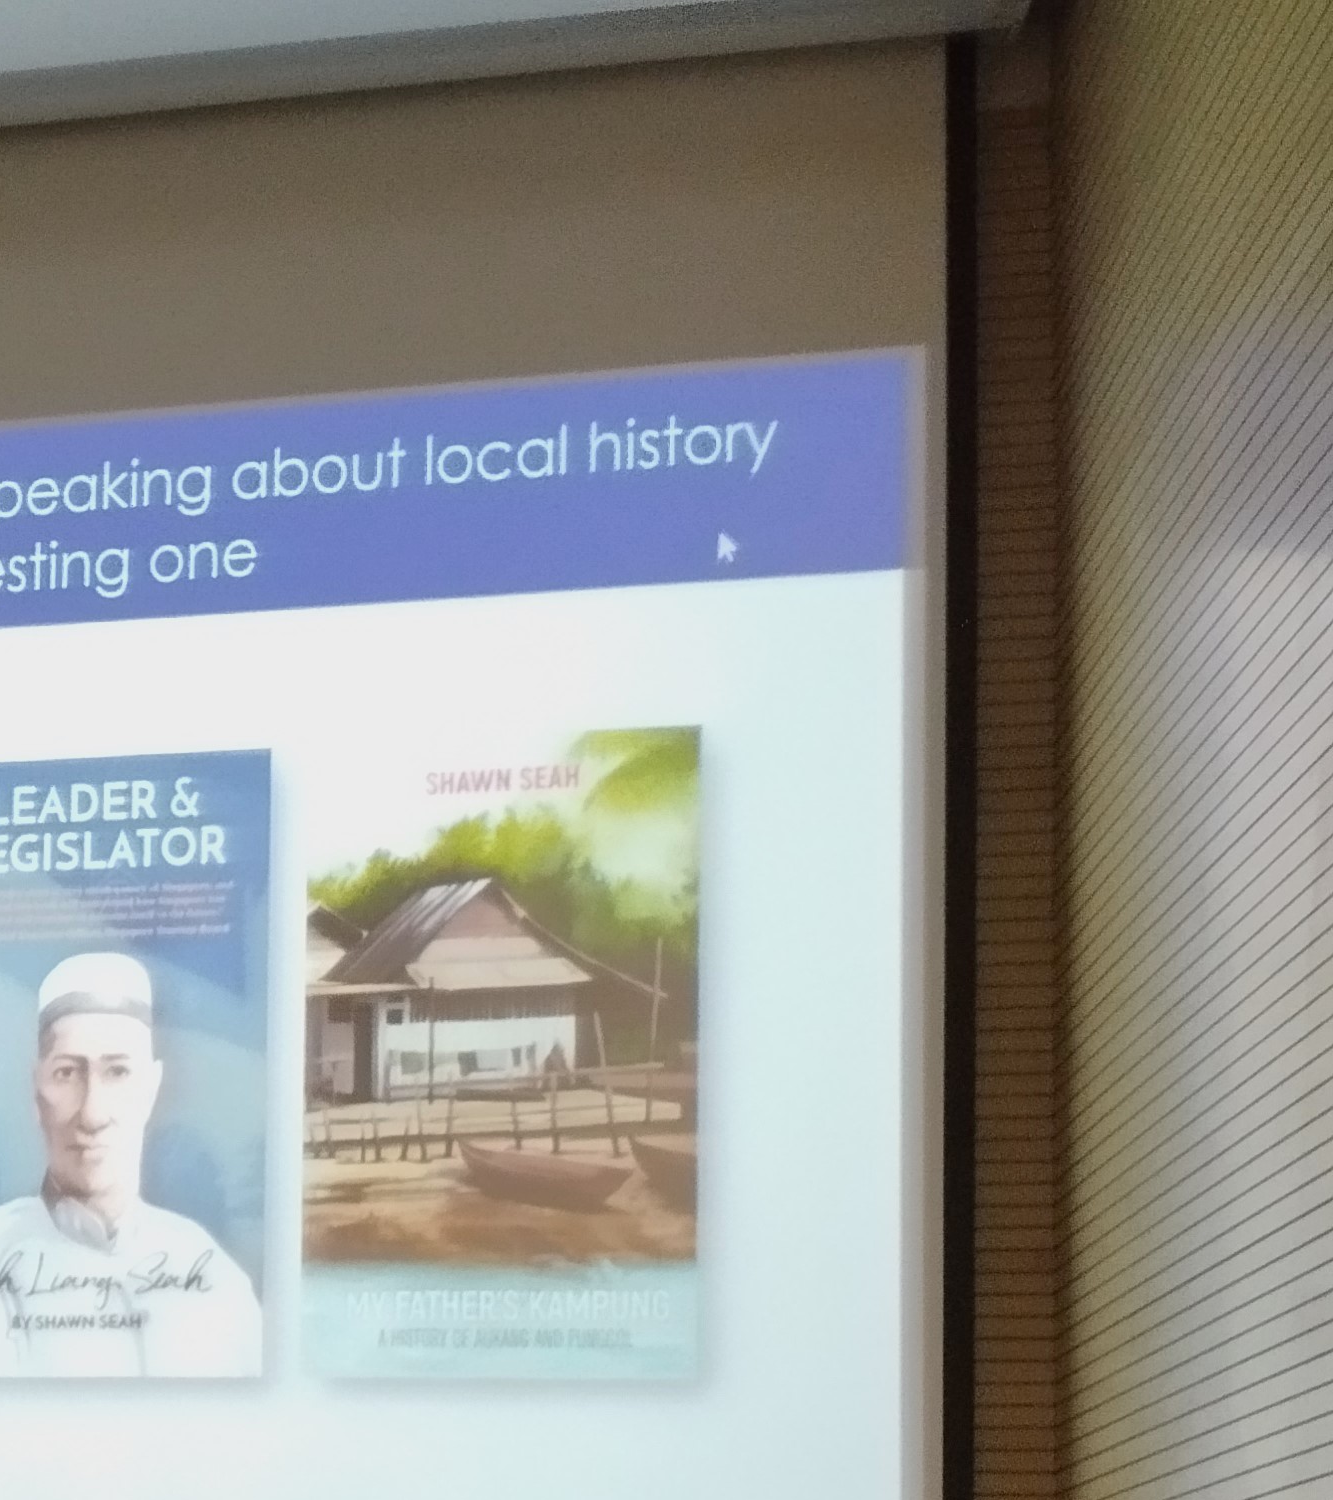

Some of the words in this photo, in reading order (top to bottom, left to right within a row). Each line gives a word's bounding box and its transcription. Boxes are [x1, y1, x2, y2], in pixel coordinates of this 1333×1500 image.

[232, 437, 407, 502] about
[425, 424, 568, 486] local
[588, 415, 779, 484] history
[149, 537, 259, 584] one
[170, 776, 200, 818] &
[426, 768, 512, 796] SHAWN
[519, 764, 580, 791] SEAH
[11, 1315, 31, 1330] BY
[34, 1315, 96, 1330] SHAWN
[98, 1314, 144, 1329] SEAH
[394, 1289, 519, 1321] FATHER'S
[530, 1289, 671, 1321] KAMPUNG
